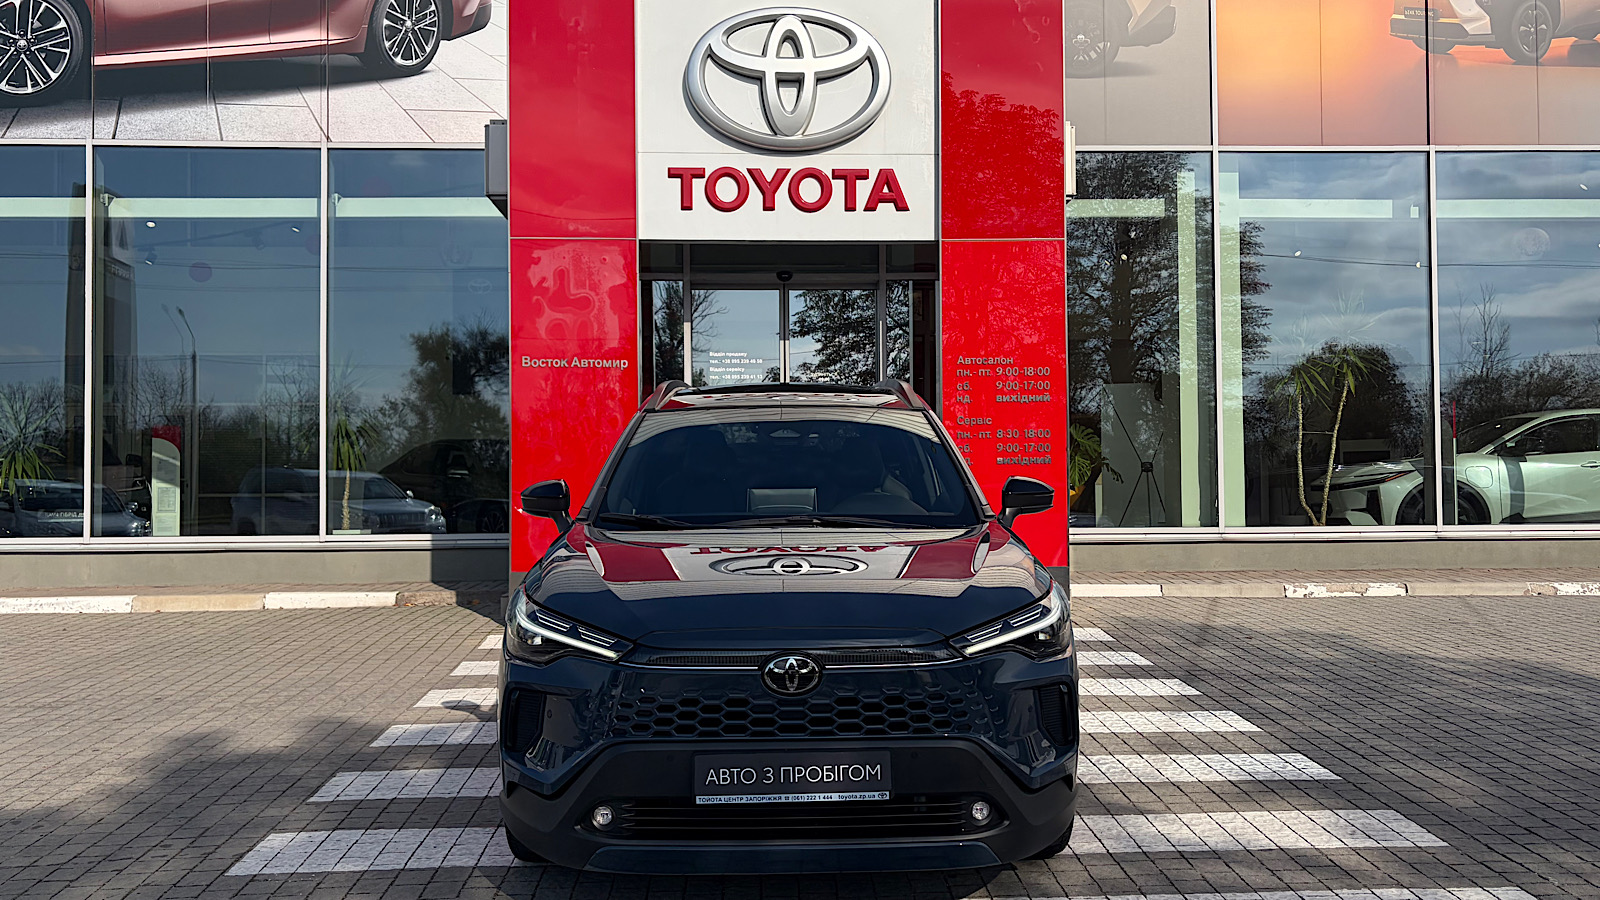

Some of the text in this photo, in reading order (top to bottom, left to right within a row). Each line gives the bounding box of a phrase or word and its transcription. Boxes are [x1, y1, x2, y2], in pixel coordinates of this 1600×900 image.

[668, 166, 910, 213] TOYOTA
[521, 355, 569, 367] Восток
[570, 356, 629, 371] Автомир
[957, 356, 1014, 365] Автосалон
[996, 367, 1051, 376] 9:00-18:00
[956, 381, 1051, 391] сб. 9:00-17:00
[996, 392, 1051, 403] вихідний
[956, 416, 993, 426] Сервіс
[996, 443, 1051, 452] 9:00-17:00
[996, 455, 1052, 466] вихідний
[705, 764, 881, 785] АВТО З ПРОБІГОМ
[838, 793, 876, 802] toyota.zp.ua
